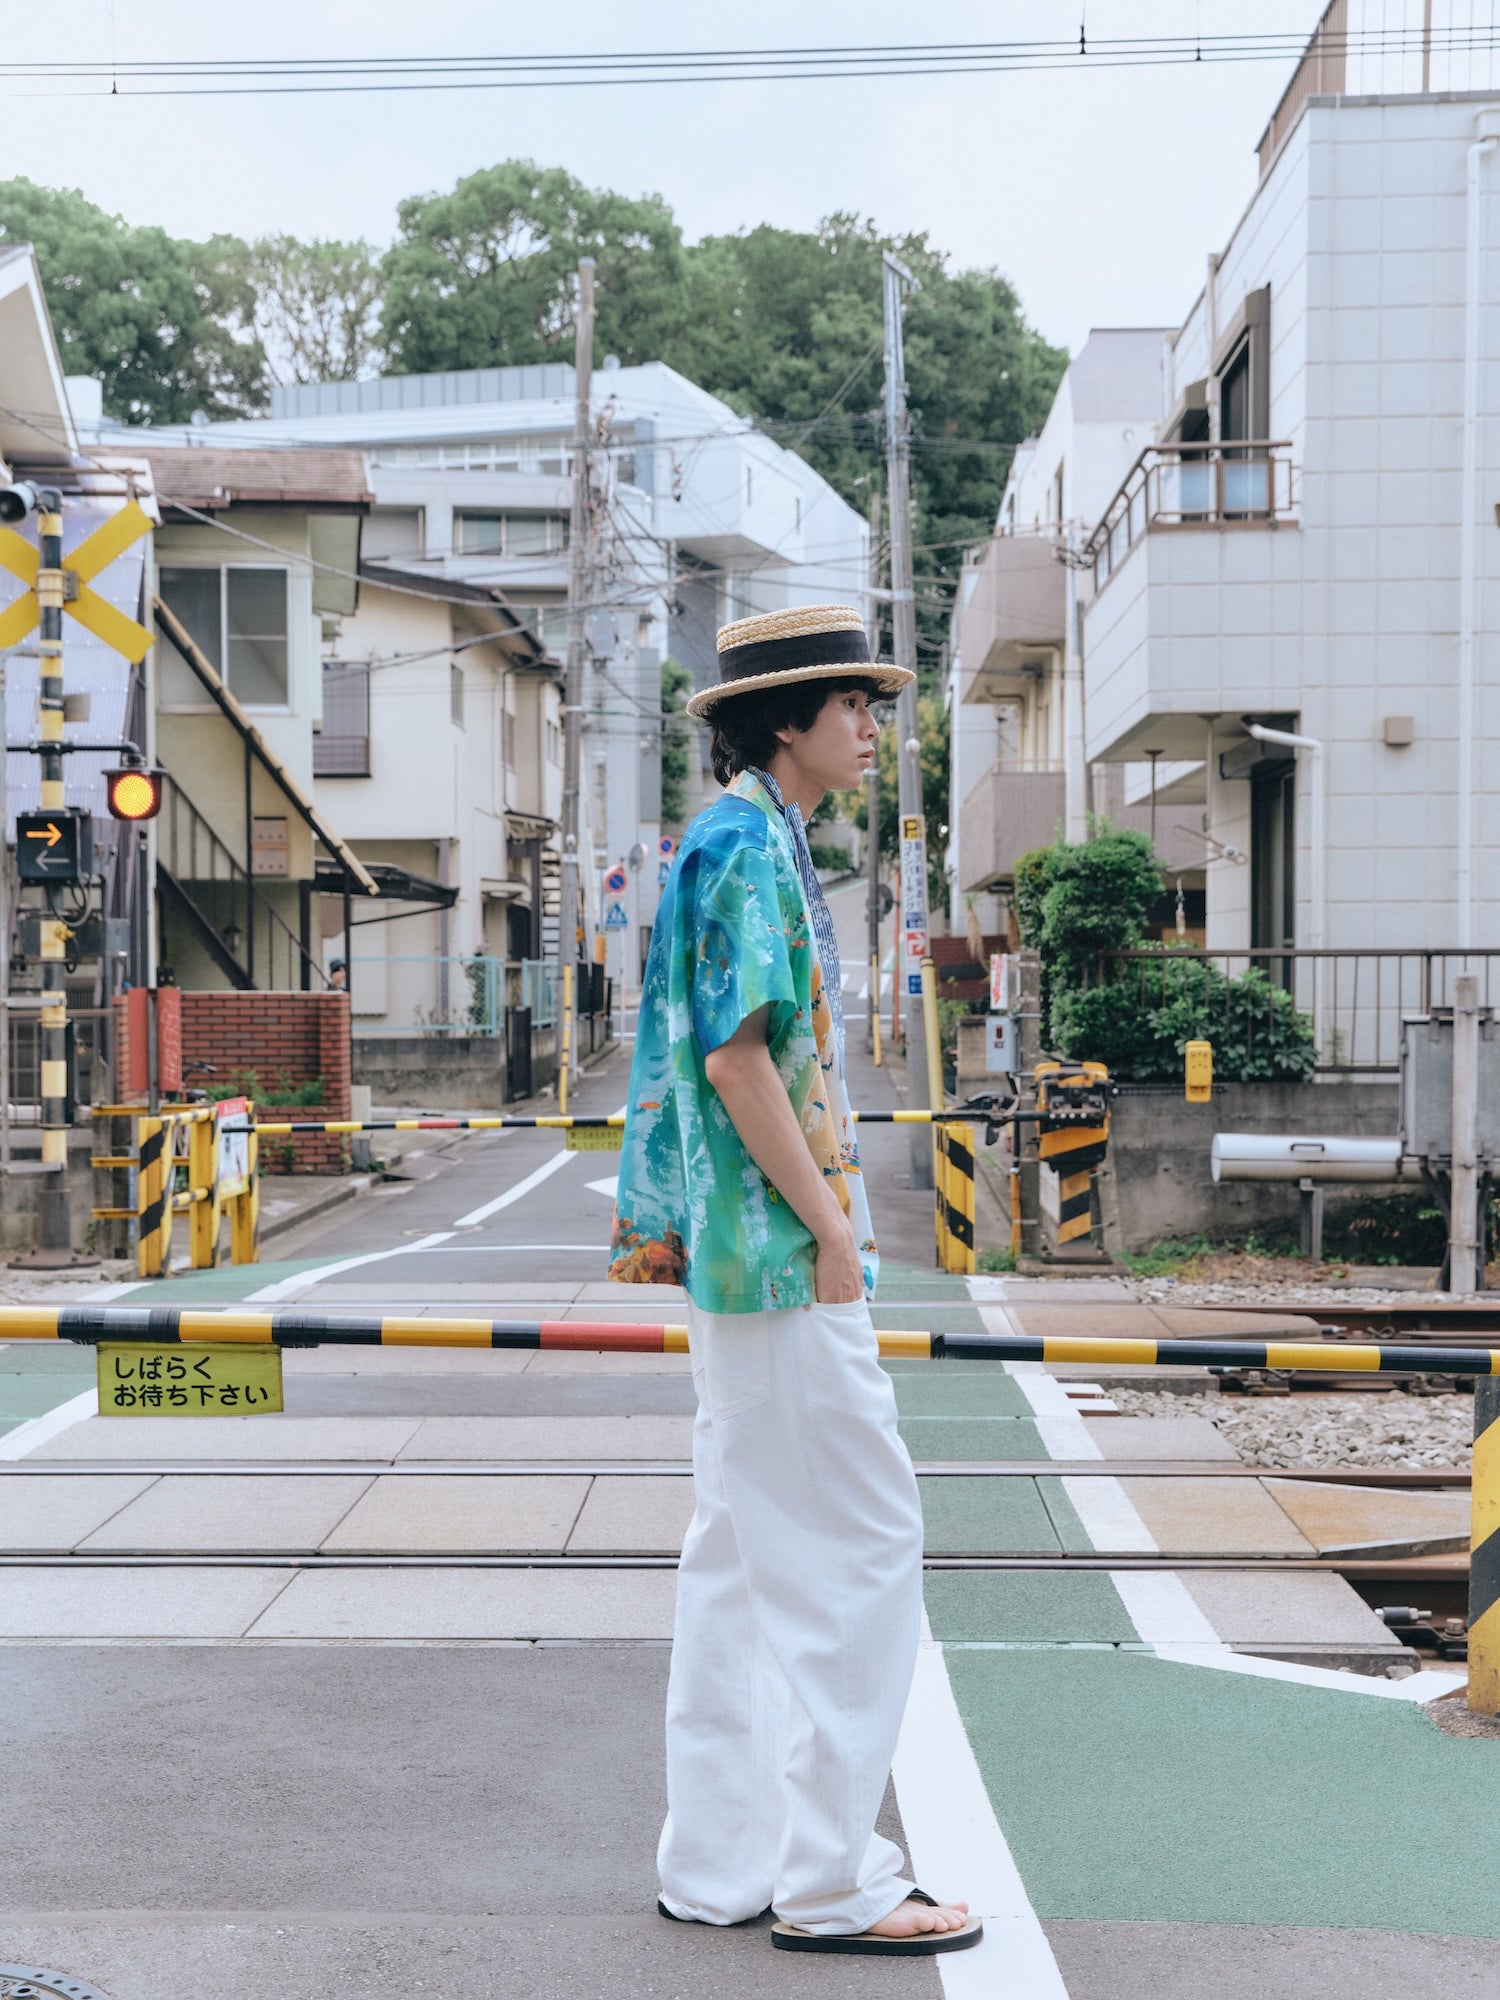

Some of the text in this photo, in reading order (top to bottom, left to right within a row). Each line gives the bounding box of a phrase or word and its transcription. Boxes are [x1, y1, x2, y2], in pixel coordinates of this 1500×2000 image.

[903, 842, 915, 911] コインパーキング
[115, 1355, 212, 1380] しばらく
[113, 1383, 269, 1407] お待ち下さい
